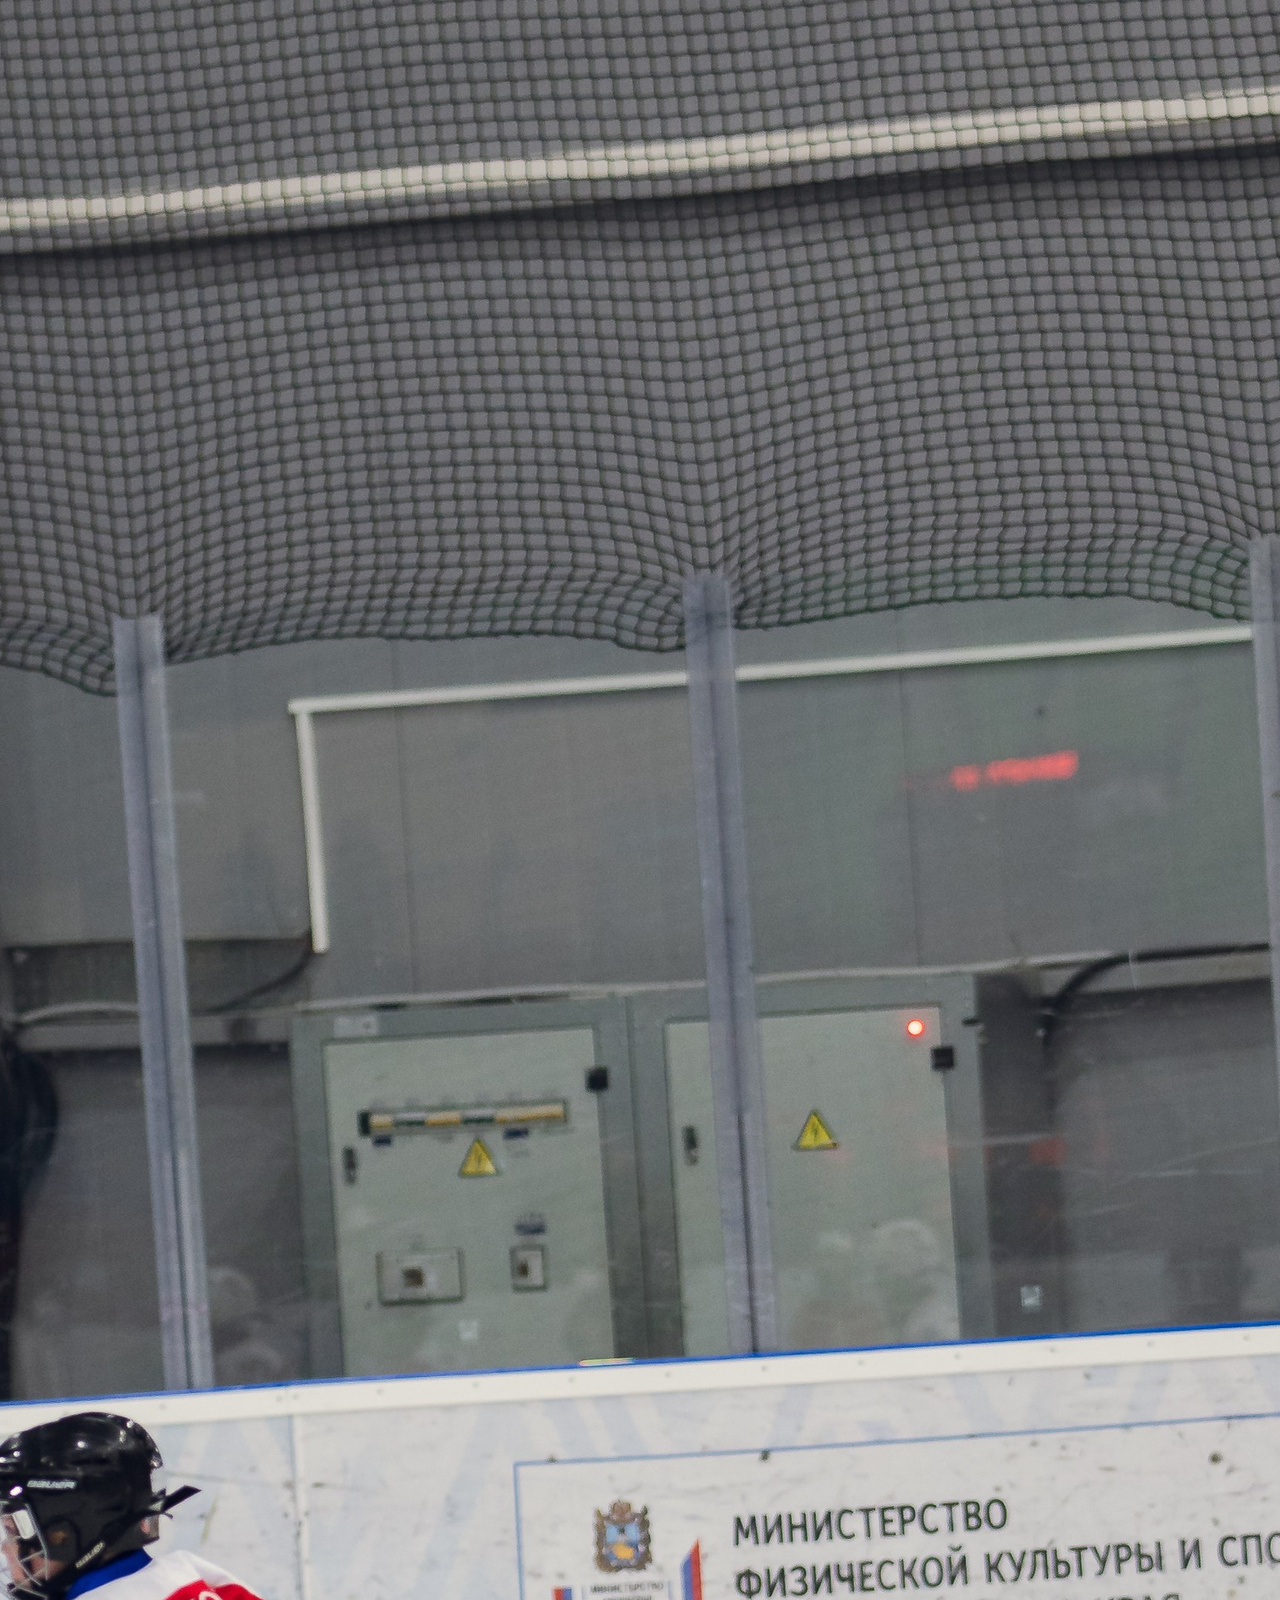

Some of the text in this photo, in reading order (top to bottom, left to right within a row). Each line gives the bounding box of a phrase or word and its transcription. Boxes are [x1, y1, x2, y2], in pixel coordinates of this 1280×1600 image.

[732, 1498, 1009, 1547] МИНИСТЕРСТВО
[735, 1545, 969, 1600] ФИЗИЧЕСКОЙ
[983, 1540, 1163, 1582] КУЛЬТУРЫ
[1178, 1538, 1202, 1570] И
